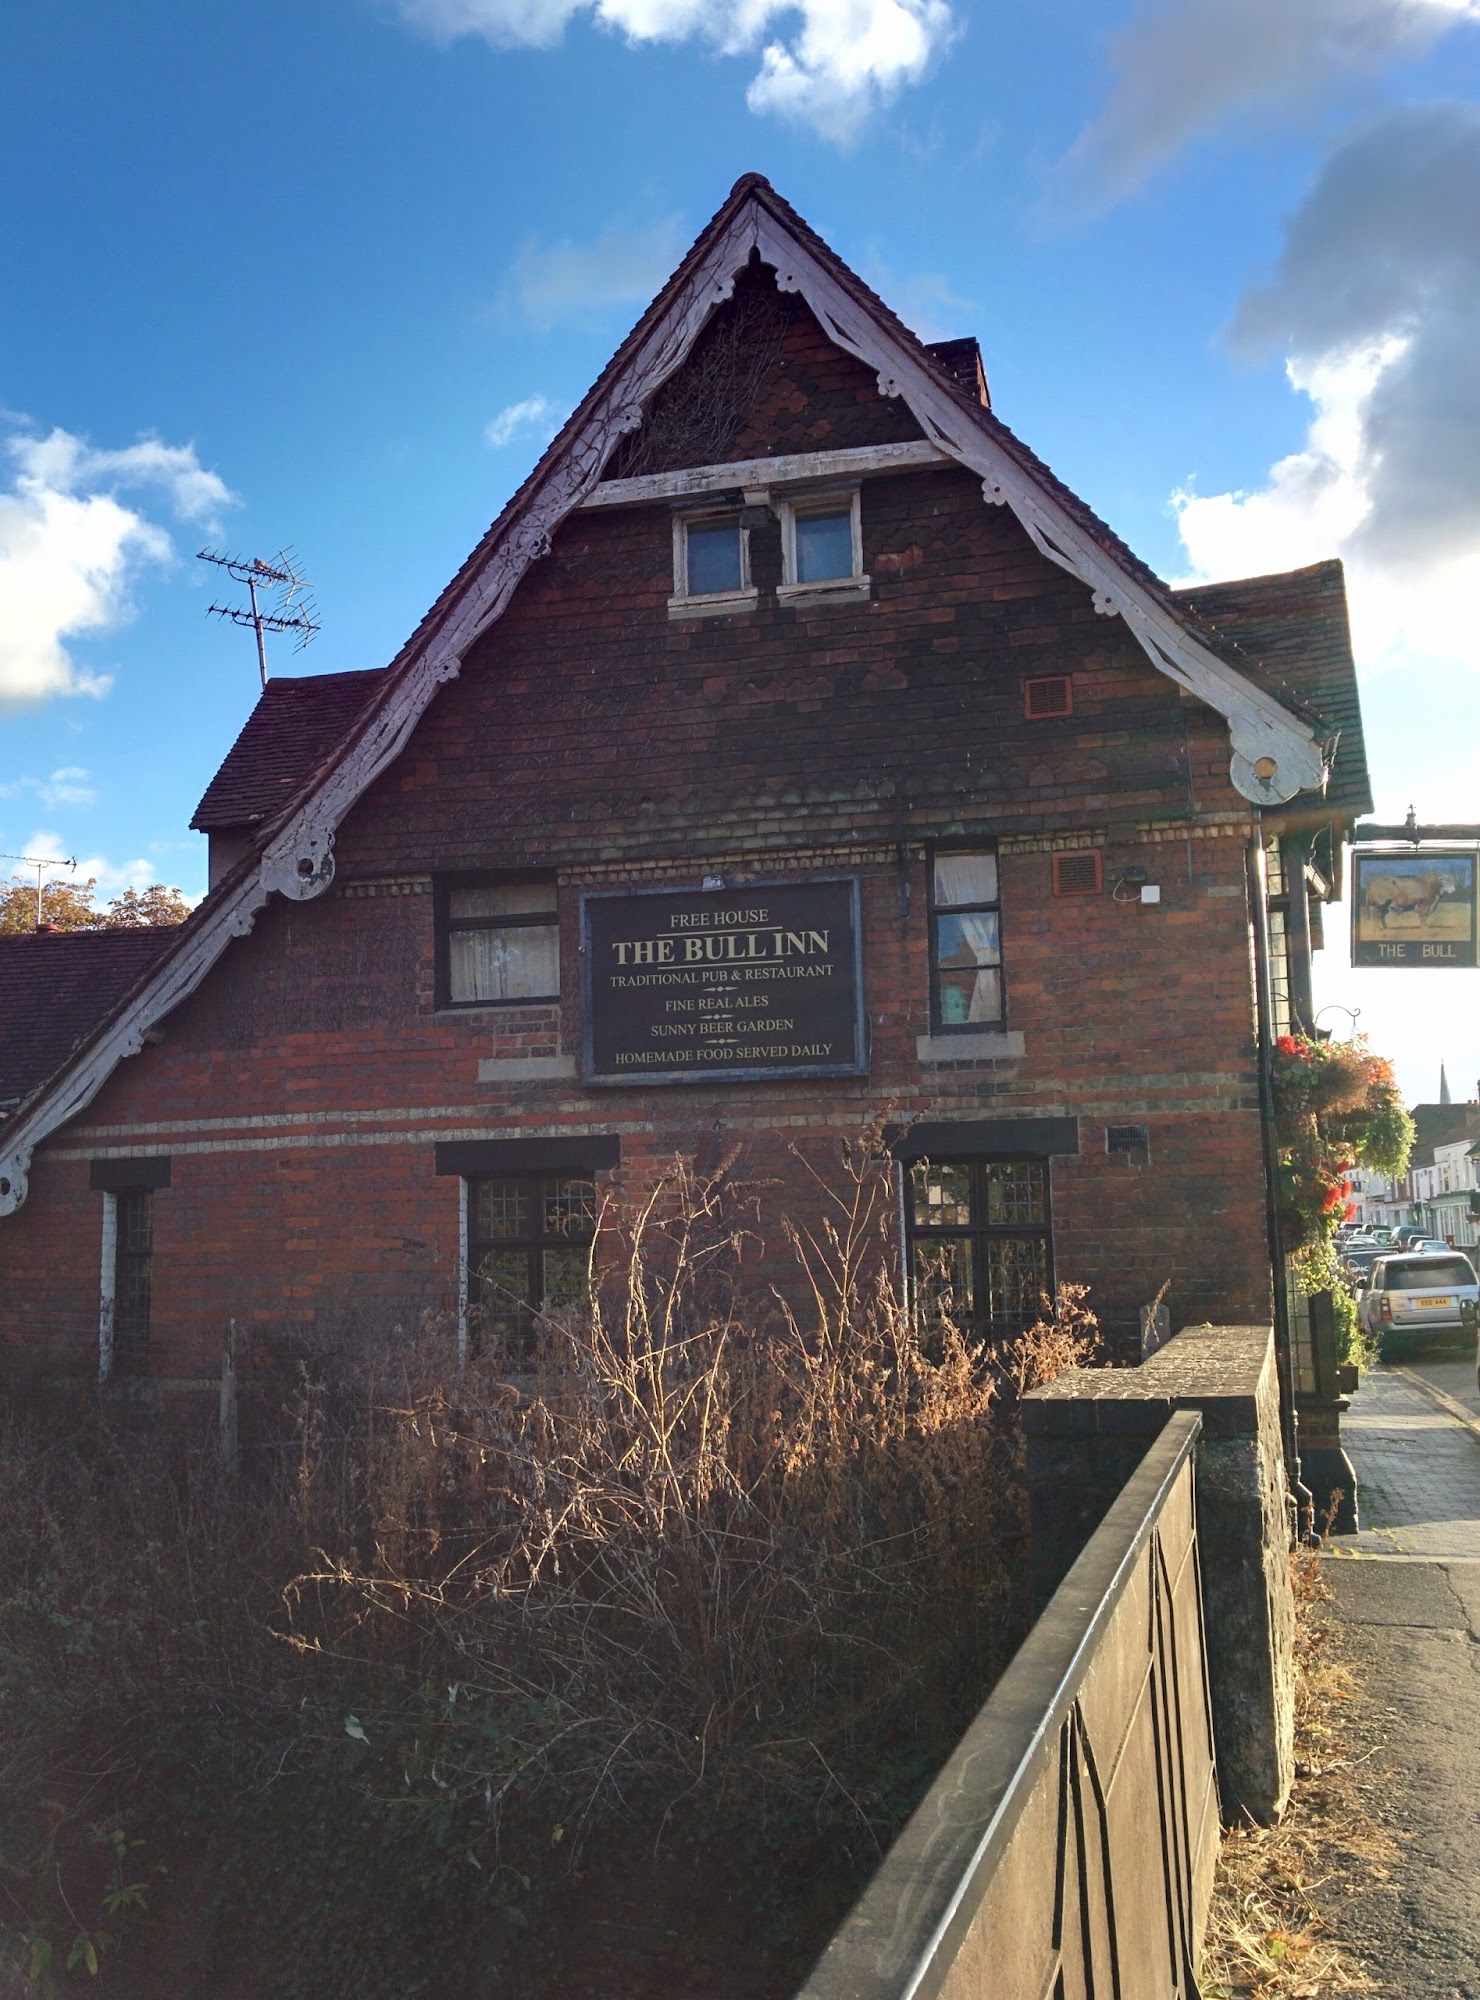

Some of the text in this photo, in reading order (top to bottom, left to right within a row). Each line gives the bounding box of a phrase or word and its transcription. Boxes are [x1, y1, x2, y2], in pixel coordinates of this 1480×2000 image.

[671, 909, 768, 928] FREE HOUSE
[613, 930, 829, 965] THE BULL INN
[1379, 944, 1457, 957] THE BULL
[610, 964, 833, 987] TRADITIONAL PUB & RESTAURANT
[665, 996, 769, 1011] FINE REAL ALES
[651, 1019, 793, 1036] SUNNY BEER GARDEN
[615, 1044, 832, 1064] HOMEMADE FOOD SERVED DAILY
